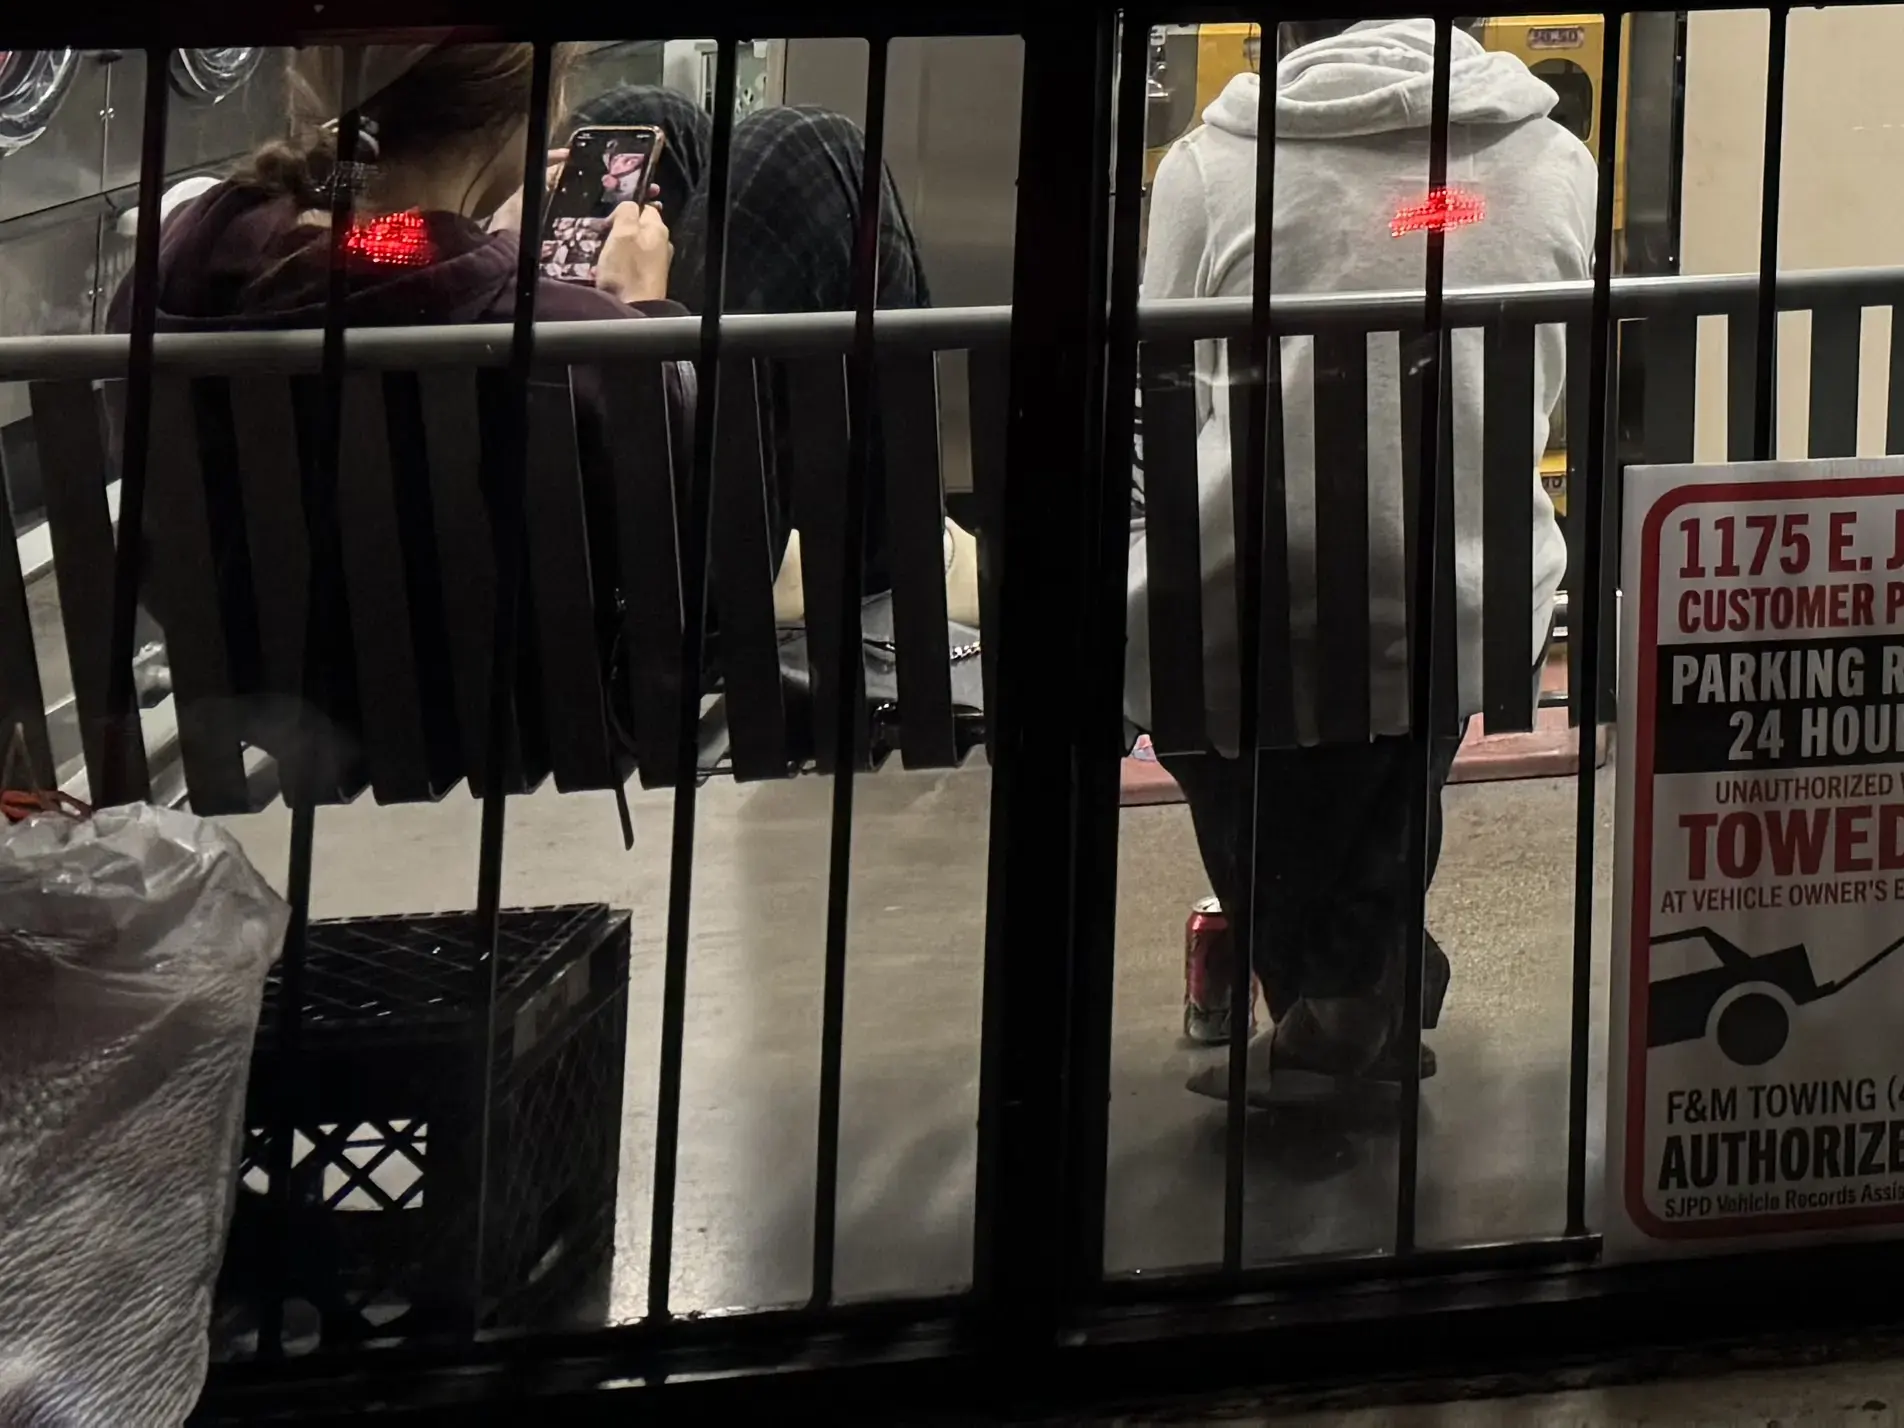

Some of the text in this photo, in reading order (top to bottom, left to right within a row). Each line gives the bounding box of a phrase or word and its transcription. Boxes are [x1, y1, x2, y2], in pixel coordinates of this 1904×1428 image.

[1678, 513, 1811, 579] 1175
[1828, 511, 1873, 572] E.
[1678, 581, 1875, 634] CUSTOMER
[1671, 647, 1865, 705] PARKING
[1728, 708, 1784, 761] 24
[1716, 772, 1894, 805] UNAUTHORIZED
[1661, 889, 1686, 914] AT
[1692, 884, 1783, 912] VEHICLE
[1789, 878, 1889, 907] OWNER'S
[1667, 1086, 1737, 1125] F&M
[1747, 1078, 1876, 1119] TOWING
[1665, 1196, 1712, 1219] SJPD
[1717, 1193, 1780, 1215] Vehicle
[1785, 1184, 1856, 1210] Records
